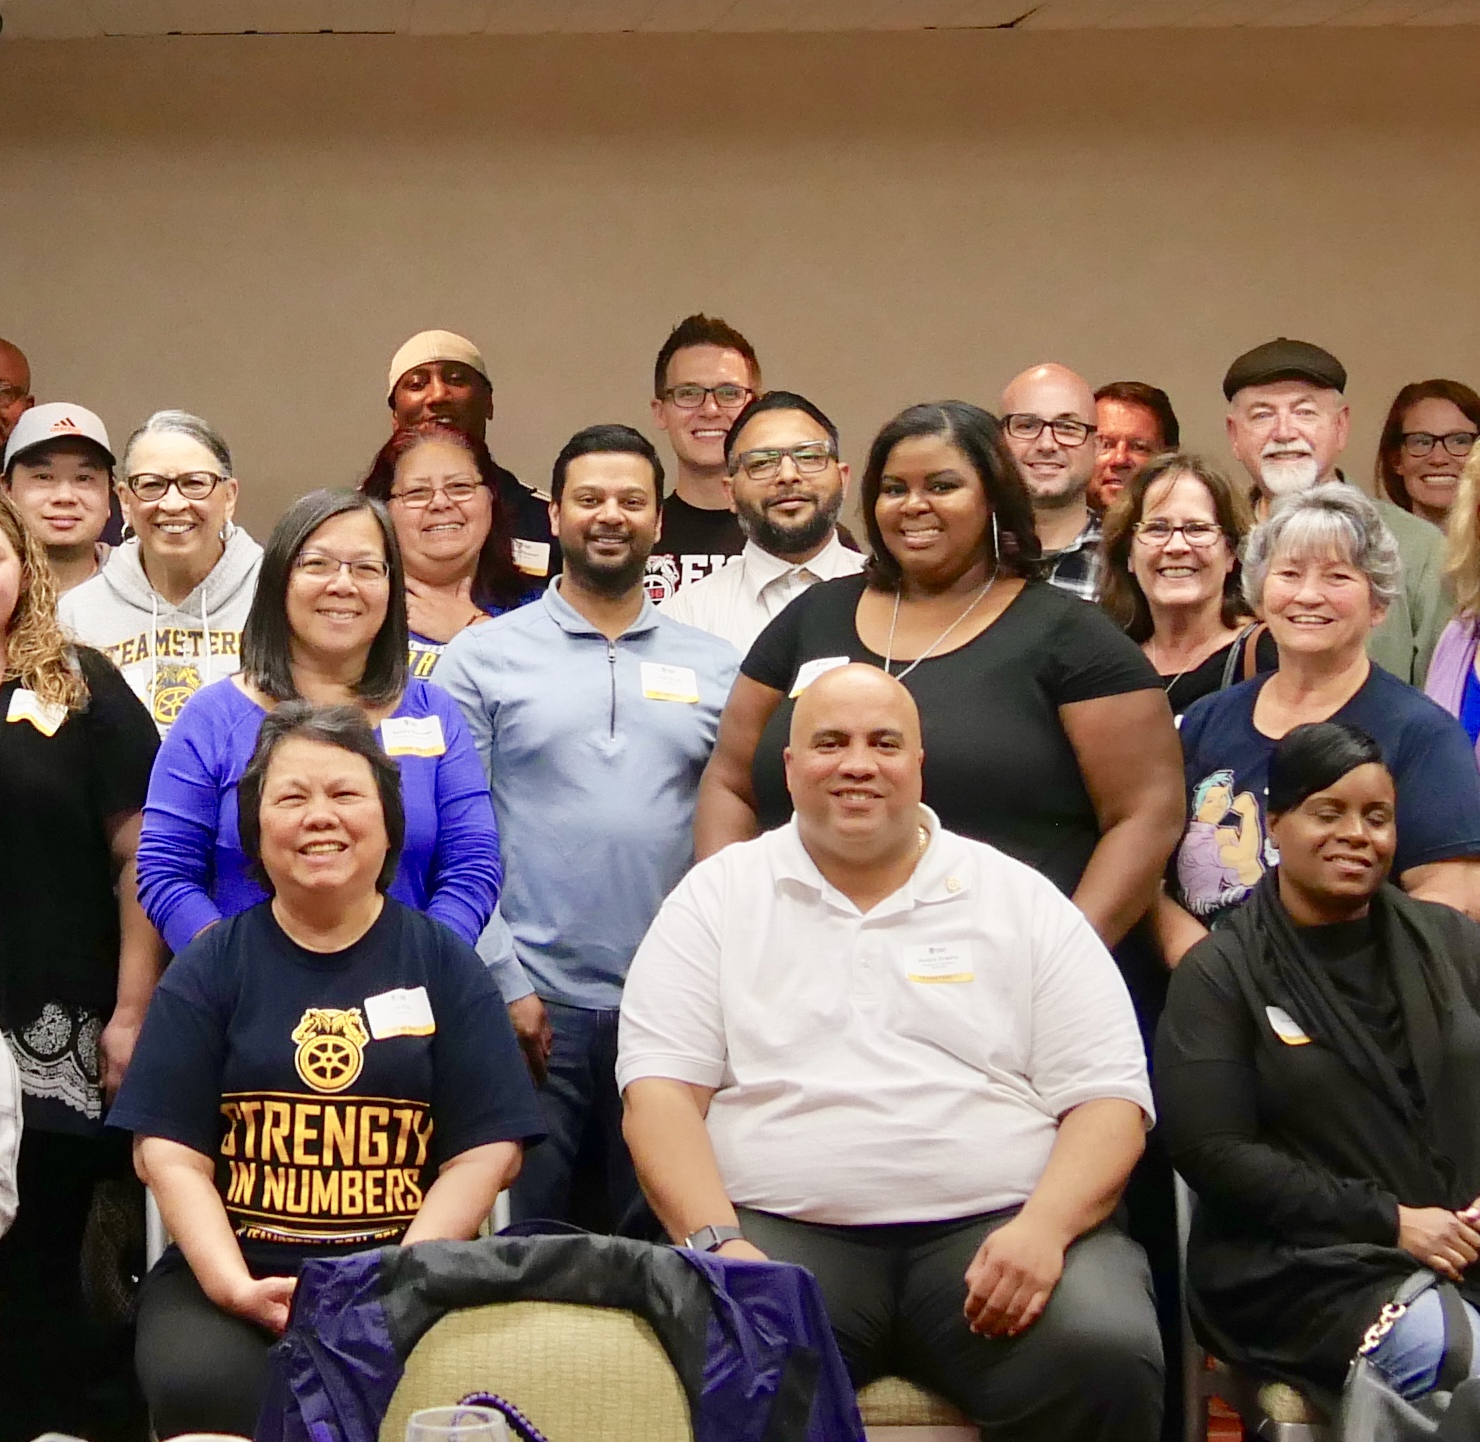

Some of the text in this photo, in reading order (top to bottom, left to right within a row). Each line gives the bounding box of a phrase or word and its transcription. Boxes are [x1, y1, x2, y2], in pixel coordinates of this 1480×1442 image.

[105, 628, 244, 668] TEAMSTER
[226, 1160, 423, 1216] IN NUMBERS
